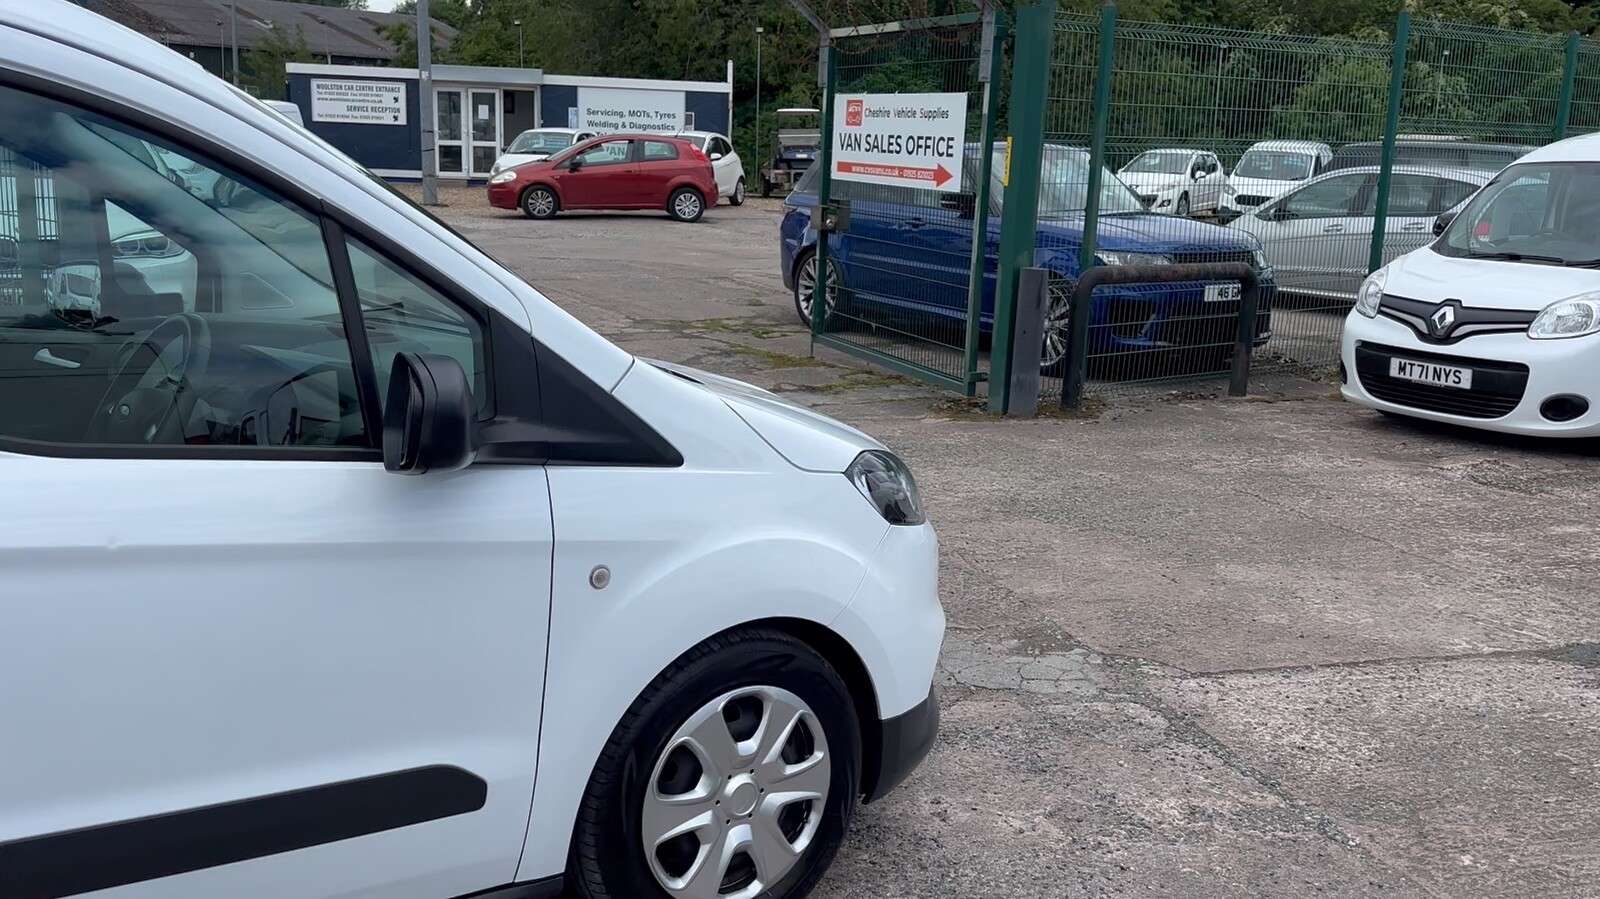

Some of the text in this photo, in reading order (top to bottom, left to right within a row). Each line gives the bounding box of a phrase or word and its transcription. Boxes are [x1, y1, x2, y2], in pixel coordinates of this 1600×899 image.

[344, 84, 354, 92] CAR
[375, 86, 400, 94] ENTRANCE
[346, 105, 400, 114] SERVICE RECEPTION
[586, 108, 677, 120] Servicing, MOTs, Tyres
[864, 105, 949, 120] Cheshire Vehicle Supplies
[587, 120, 675, 131] Welding & Diagnostics
[839, 132, 955, 157] VAN SALES OFFICE
[1398, 360, 1429, 379] MT71
[1432, 366, 1462, 384] NYS
